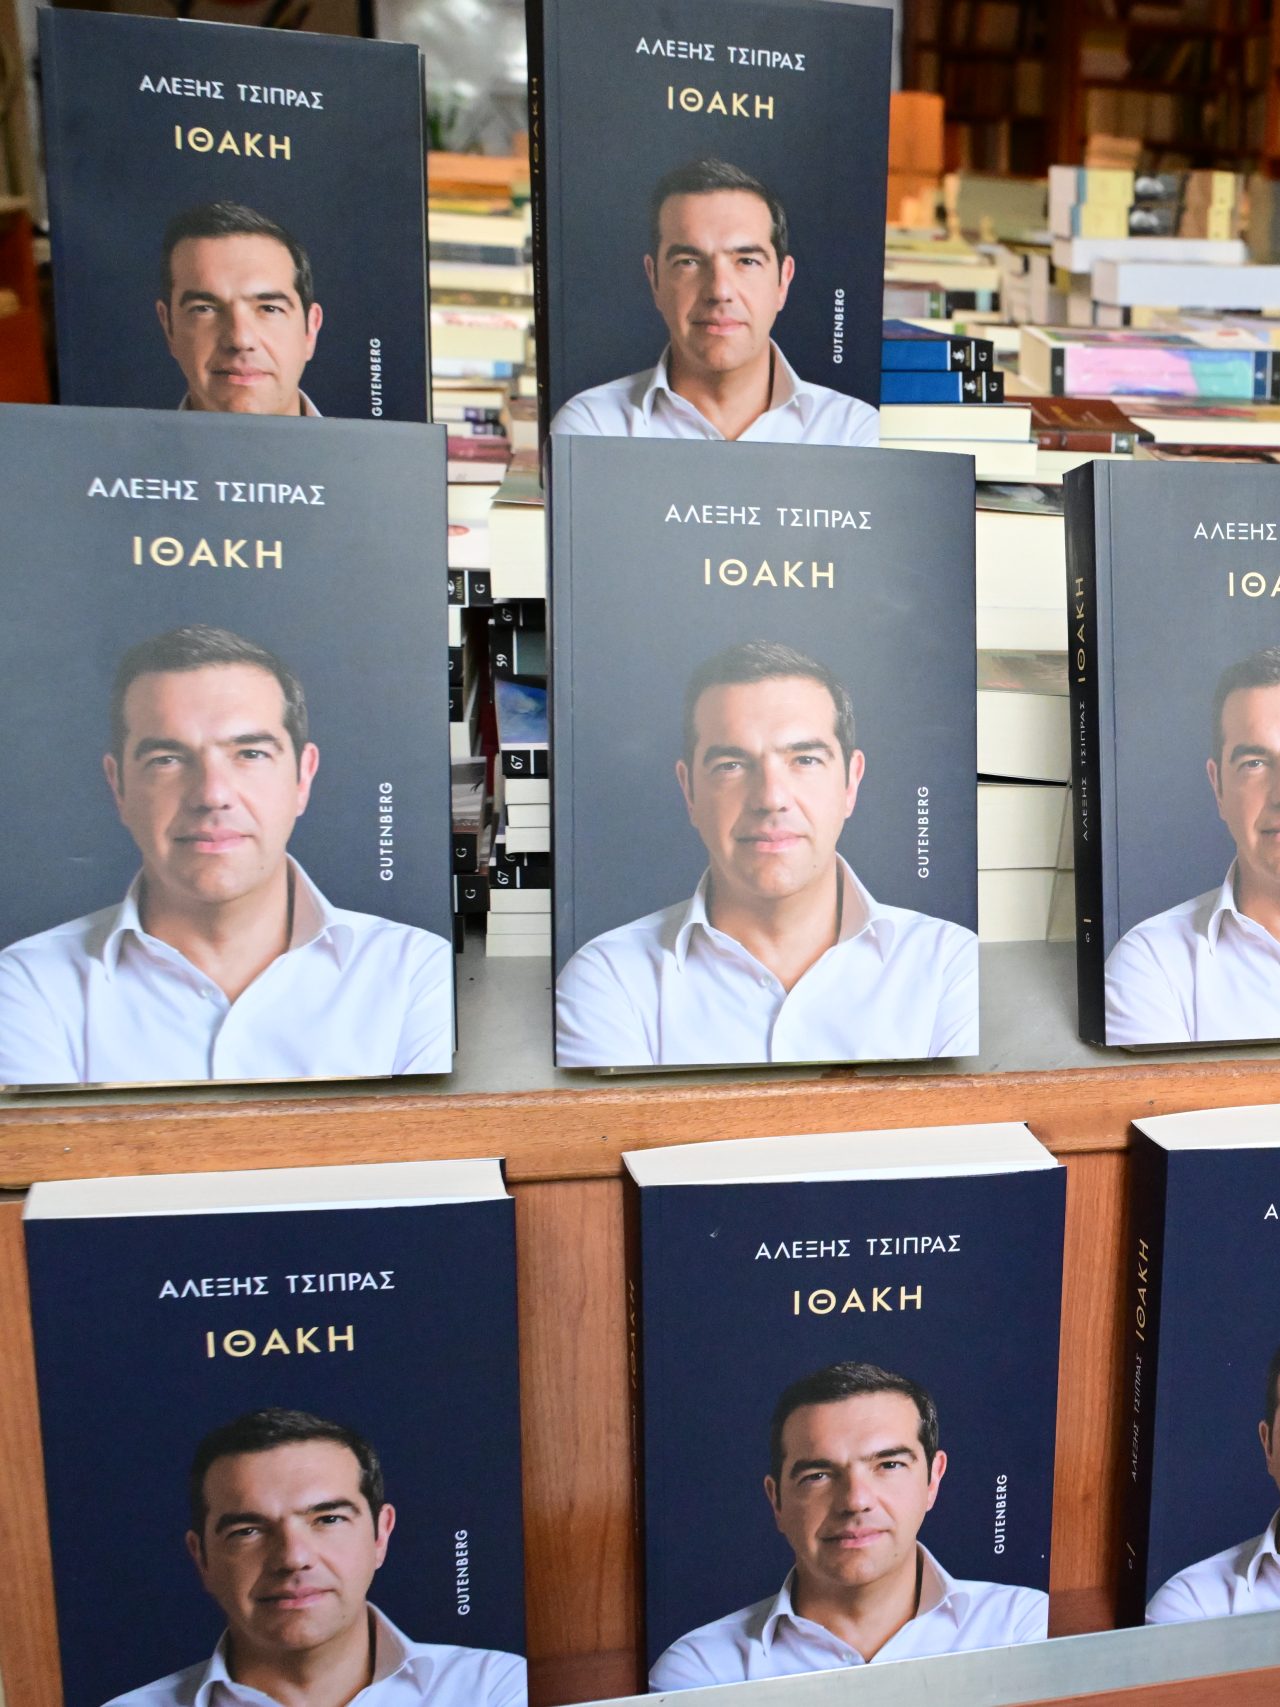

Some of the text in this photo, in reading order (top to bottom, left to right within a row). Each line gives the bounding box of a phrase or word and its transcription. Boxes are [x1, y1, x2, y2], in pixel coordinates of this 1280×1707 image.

[636, 38, 805, 71] ΑΛΕΞΗΣ ΤΣΙΠΡΑΣ
[140, 75, 323, 109] ΑΛΕΞΗΣ ΤΣΙΠΡΑΣ
[668, 86, 773, 119] ΙΘΑΚΗ
[175, 125, 290, 160] ΙΘΑΚΗ
[833, 289, 844, 363] GUTENBERG
[978, 352, 988, 362] G
[370, 338, 382, 416] GUTENBERG
[988, 382, 998, 392] G
[88, 478, 325, 505] ΑΛΕΞΗΣ ΤΣΙΠΡΑΣ
[665, 504, 871, 529] ΑΛΕΞΗΣ ΤΣΙΠΡΑΣ
[1194, 522, 1277, 540] ΑΛΕΞΗΣ
[134, 536, 282, 568] ΙΘΑΚΗ
[475, 584, 485, 594] G
[705, 559, 833, 588] ΙΘΑΚΗ
[1075, 578, 1086, 683] ΙΘΑΚΗ
[496, 653, 508, 667] 59
[511, 755, 523, 769] 67
[1081, 776, 1089, 842] ΑΛΕΞΗΣ
[379, 783, 393, 880] GUTENBERG
[918, 787, 929, 878] GUTENBERG
[456, 848, 467, 858] G
[497, 871, 509, 884] 67
[465, 889, 476, 899] G
[755, 1235, 960, 1259] ΑΛΕΞΗΣ ΤΣΙΠΡΑΣ
[159, 1271, 395, 1298] ΑΛΕΞΗΣ ΤΣΙΠΡΑΣ
[794, 1285, 921, 1315] ΙΘΑΚΗ
[1136, 1238, 1149, 1341] ΙΘΑΚΗ
[207, 1325, 353, 1358] ΙΘΑΚΗ
[994, 1475, 1007, 1554] GUTENBERG
[455, 1530, 470, 1615] GUTENBERG
